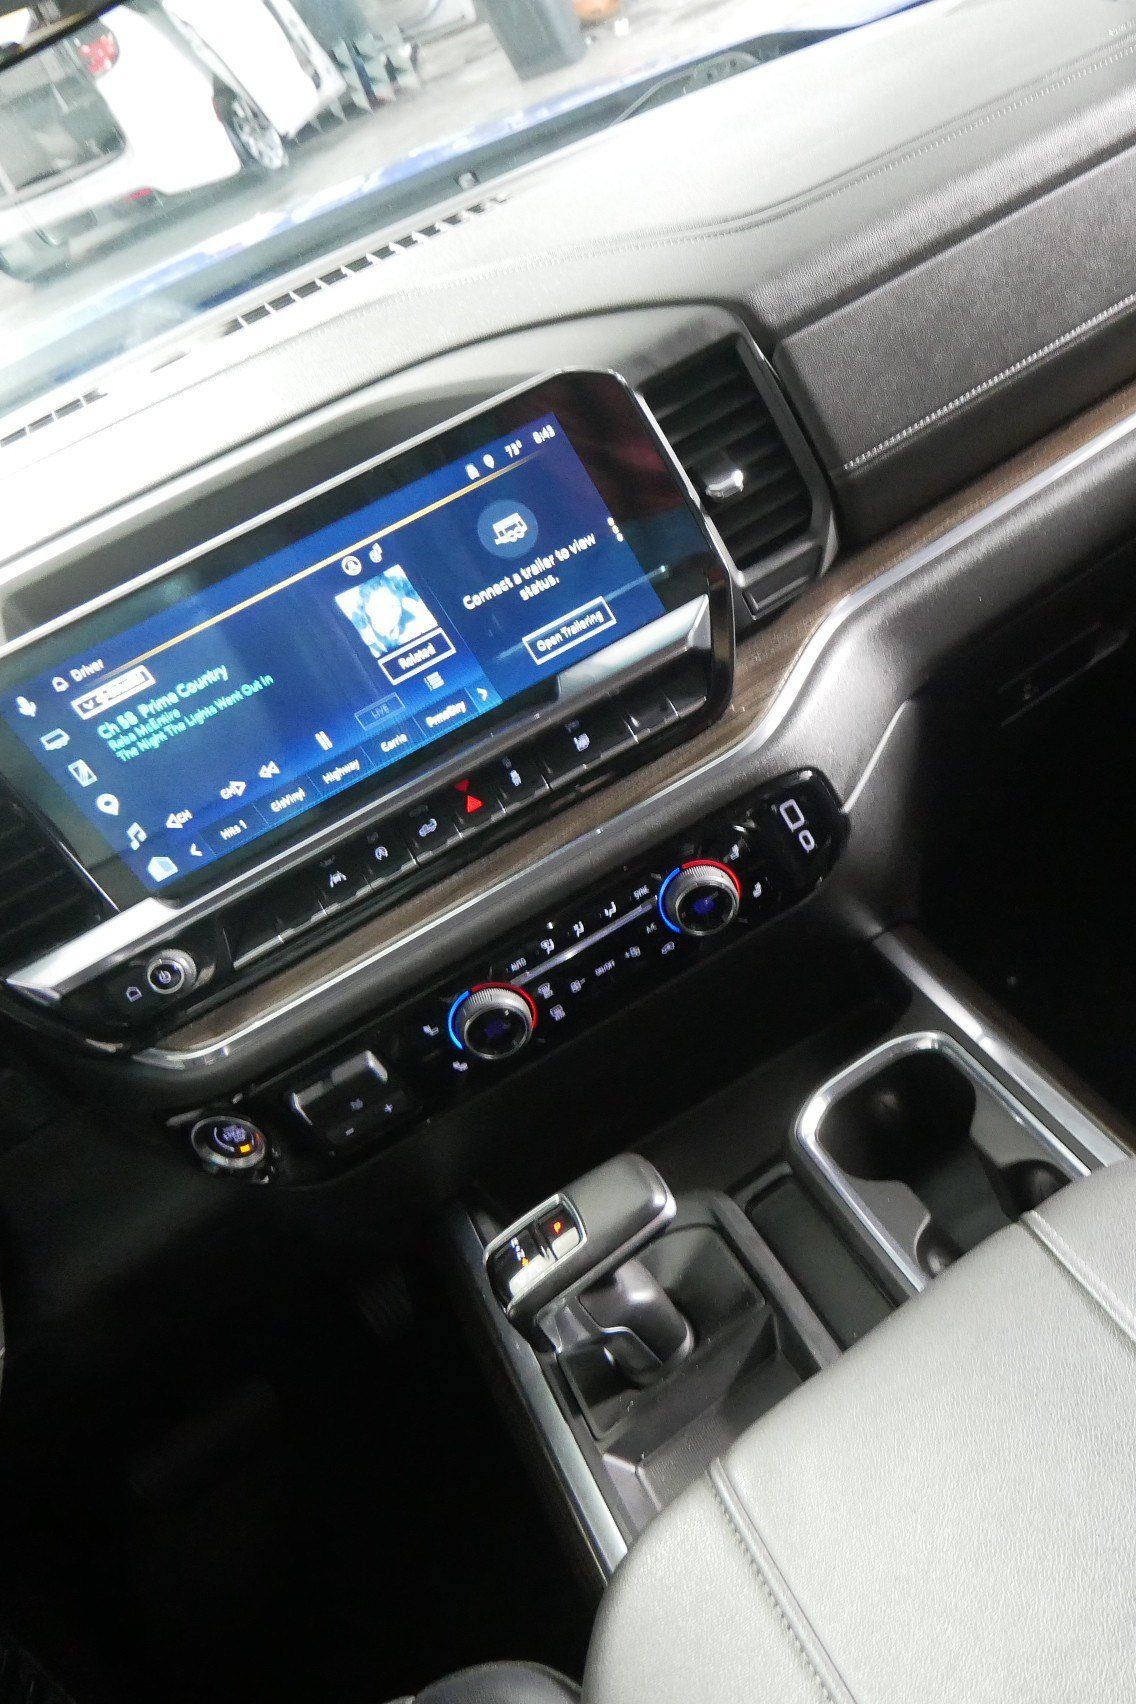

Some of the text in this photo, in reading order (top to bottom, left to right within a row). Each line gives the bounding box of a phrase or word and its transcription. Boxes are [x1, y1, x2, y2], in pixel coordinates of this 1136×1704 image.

[462, 533, 597, 610] Connect a trailer to view
[536, 611, 605, 652] Open Trailering
[397, 642, 437, 670] Related
[70, 658, 104, 682] Driver
[97, 721, 121, 740] Ch
[137, 691, 180, 719] Prime
[175, 665, 229, 698] Country
[370, 702, 390, 719] LIVE
[115, 747, 140, 762] The
[136, 731, 168, 752] Night
[163, 722, 187, 737] The
[184, 704, 218, 728] Lights
[213, 690, 244, 711] Went
[240, 679, 264, 697] Out
[108, 731, 138, 751] Reba
[322, 759, 361, 785] Highway
[220, 819, 248, 840] Hits 1
[510, 957, 527, 972] AUTO
